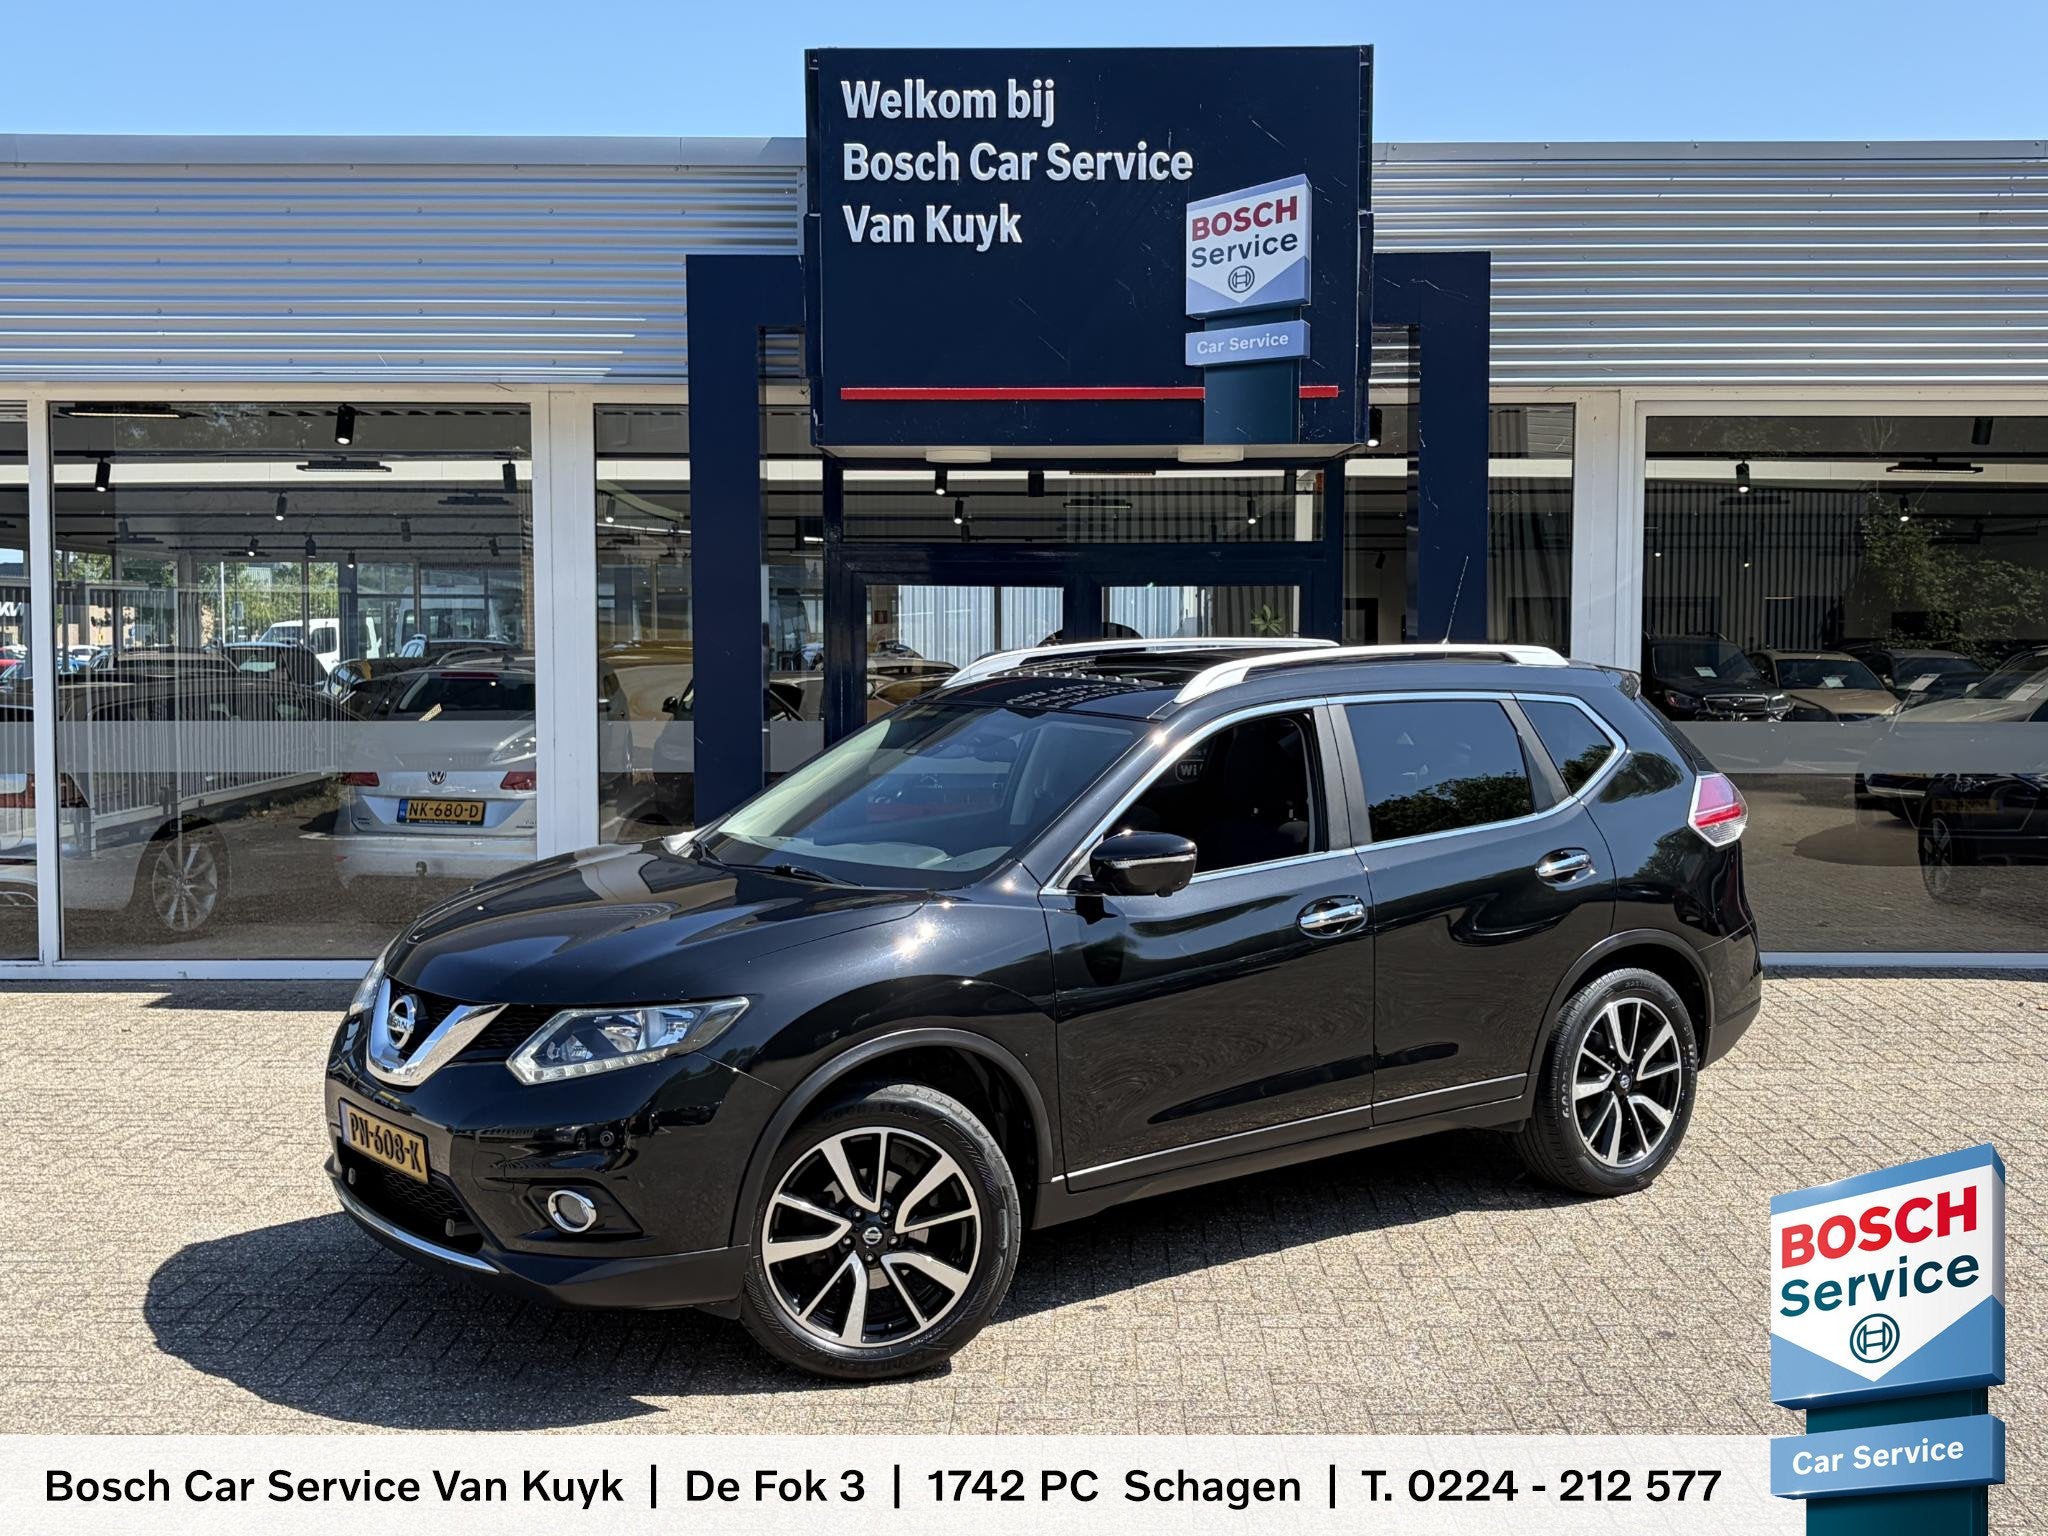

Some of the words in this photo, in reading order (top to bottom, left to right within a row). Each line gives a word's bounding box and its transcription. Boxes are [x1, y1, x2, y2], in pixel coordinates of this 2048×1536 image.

[841, 79, 996, 119] Welkom
[1008, 79, 1055, 127] bij
[843, 141, 960, 181] Bosch
[970, 143, 1038, 181] Car
[1047, 141, 1193, 181] Service
[842, 206, 915, 243] Van
[927, 204, 1023, 252] Kuyk
[1192, 195, 1297, 241] BOSCH
[1191, 233, 1298, 268] Service
[1196, 340, 1225, 354] Car
[1229, 333, 1289, 351] Service
[408, 802, 479, 819] NK-680-D
[349, 1112, 422, 1173] PN-608-K
